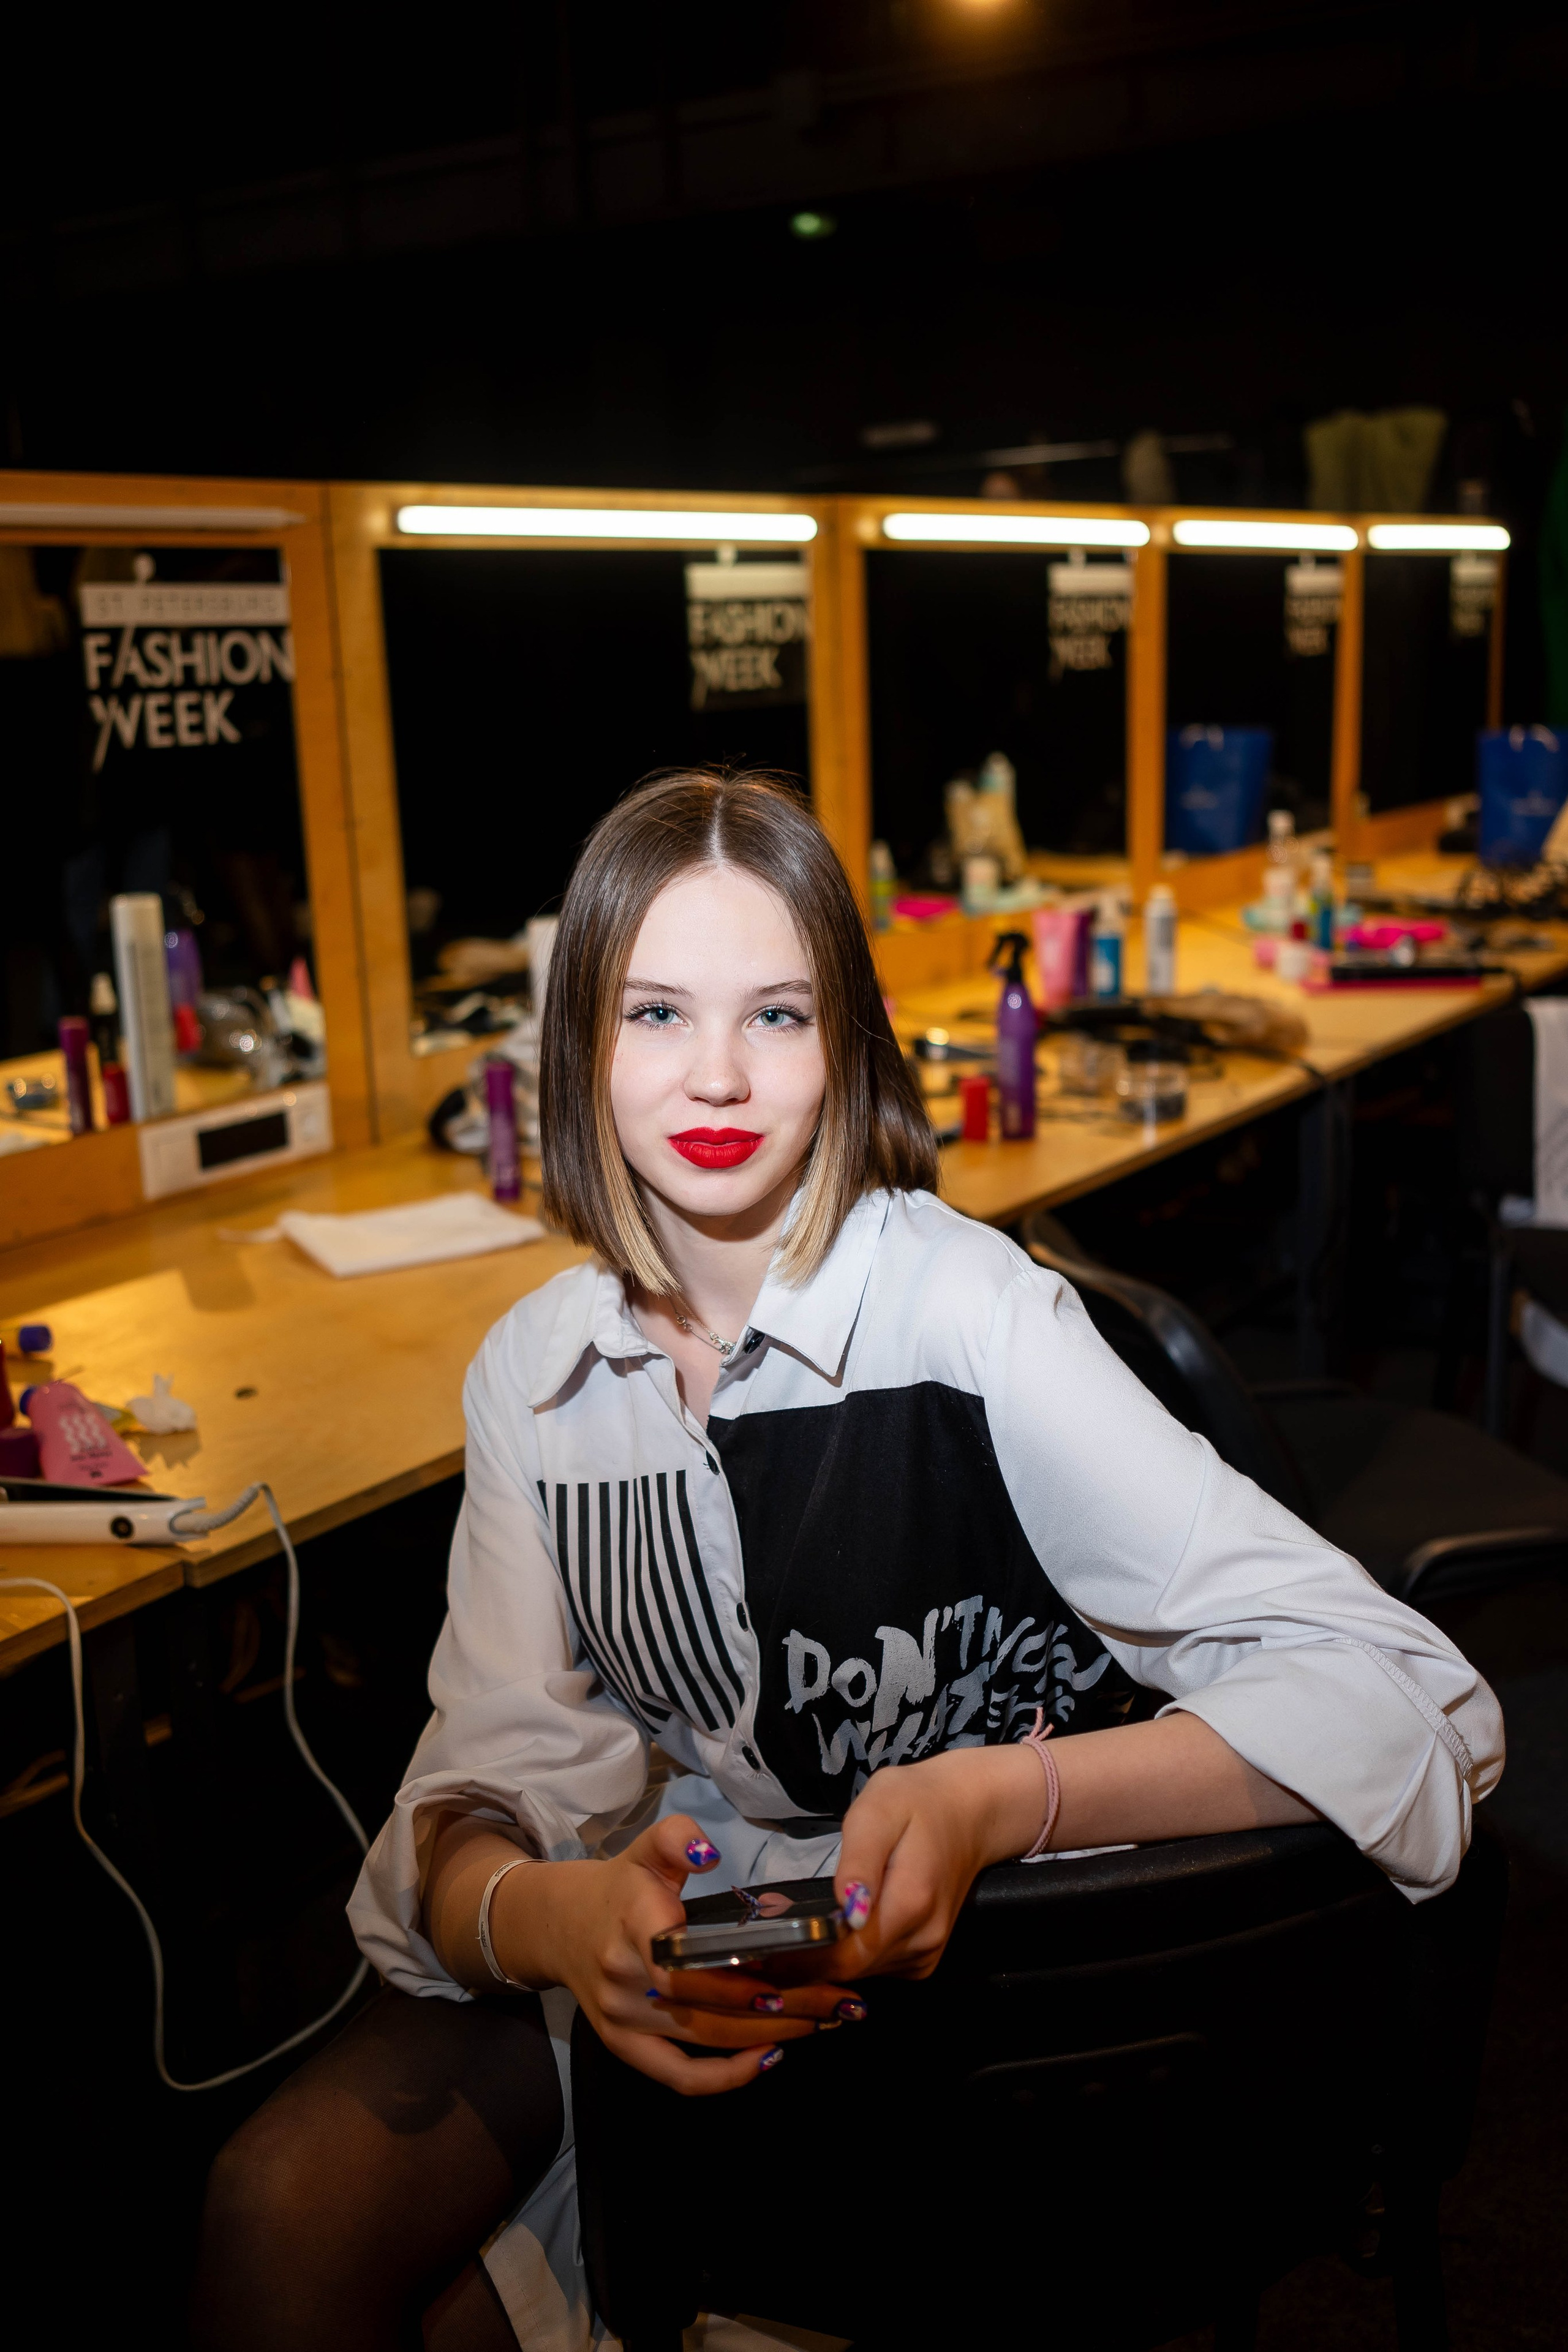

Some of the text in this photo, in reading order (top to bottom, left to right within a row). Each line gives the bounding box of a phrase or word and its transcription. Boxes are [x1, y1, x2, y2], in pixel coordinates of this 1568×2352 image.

[82, 630, 296, 691] FASHION
[690, 647, 783, 709] WEEK
[89, 688, 242, 771] WEEK
[782, 1595, 983, 1732] DON'T
